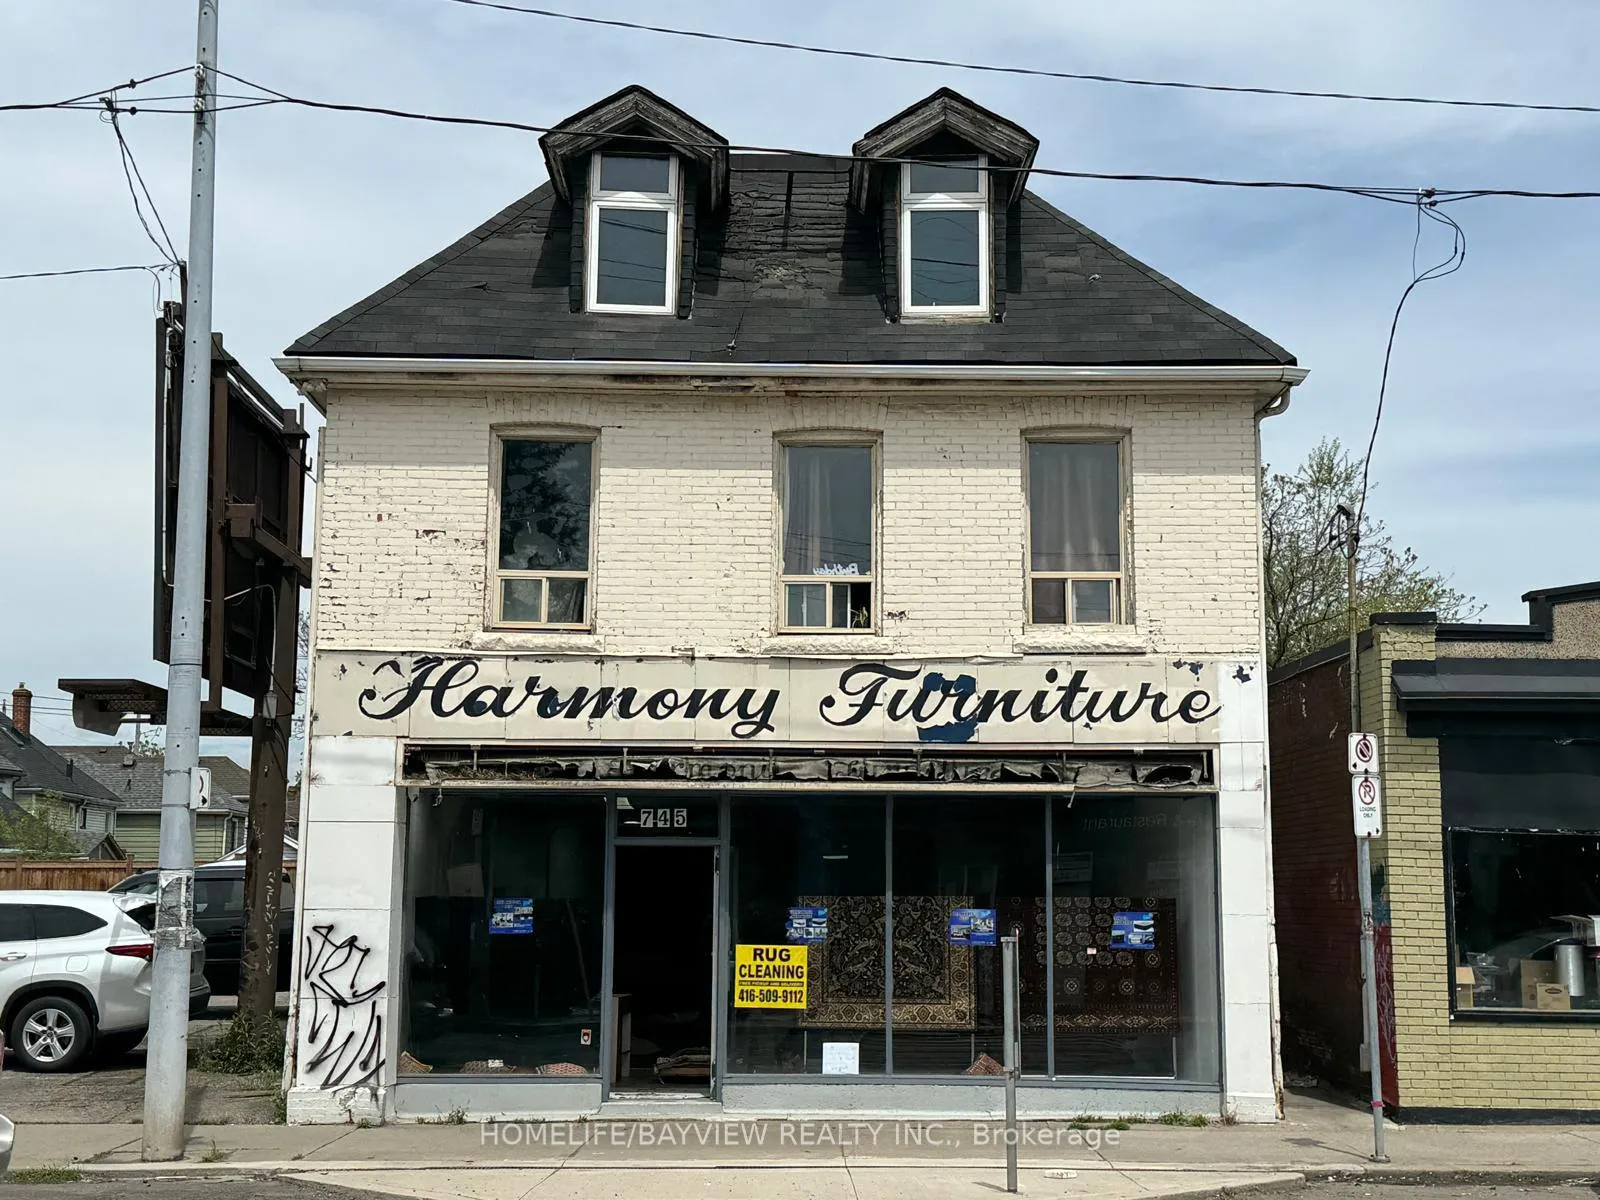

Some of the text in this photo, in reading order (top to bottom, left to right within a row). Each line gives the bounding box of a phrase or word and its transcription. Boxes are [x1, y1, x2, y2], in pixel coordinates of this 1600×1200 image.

[358, 656, 1222, 739] Harmony Furniture
[641, 809, 687, 827] 745
[753, 948, 790, 961] RUG
[739, 964, 804, 979] CLEANING
[738, 989, 803, 1003] 416-509-9112
